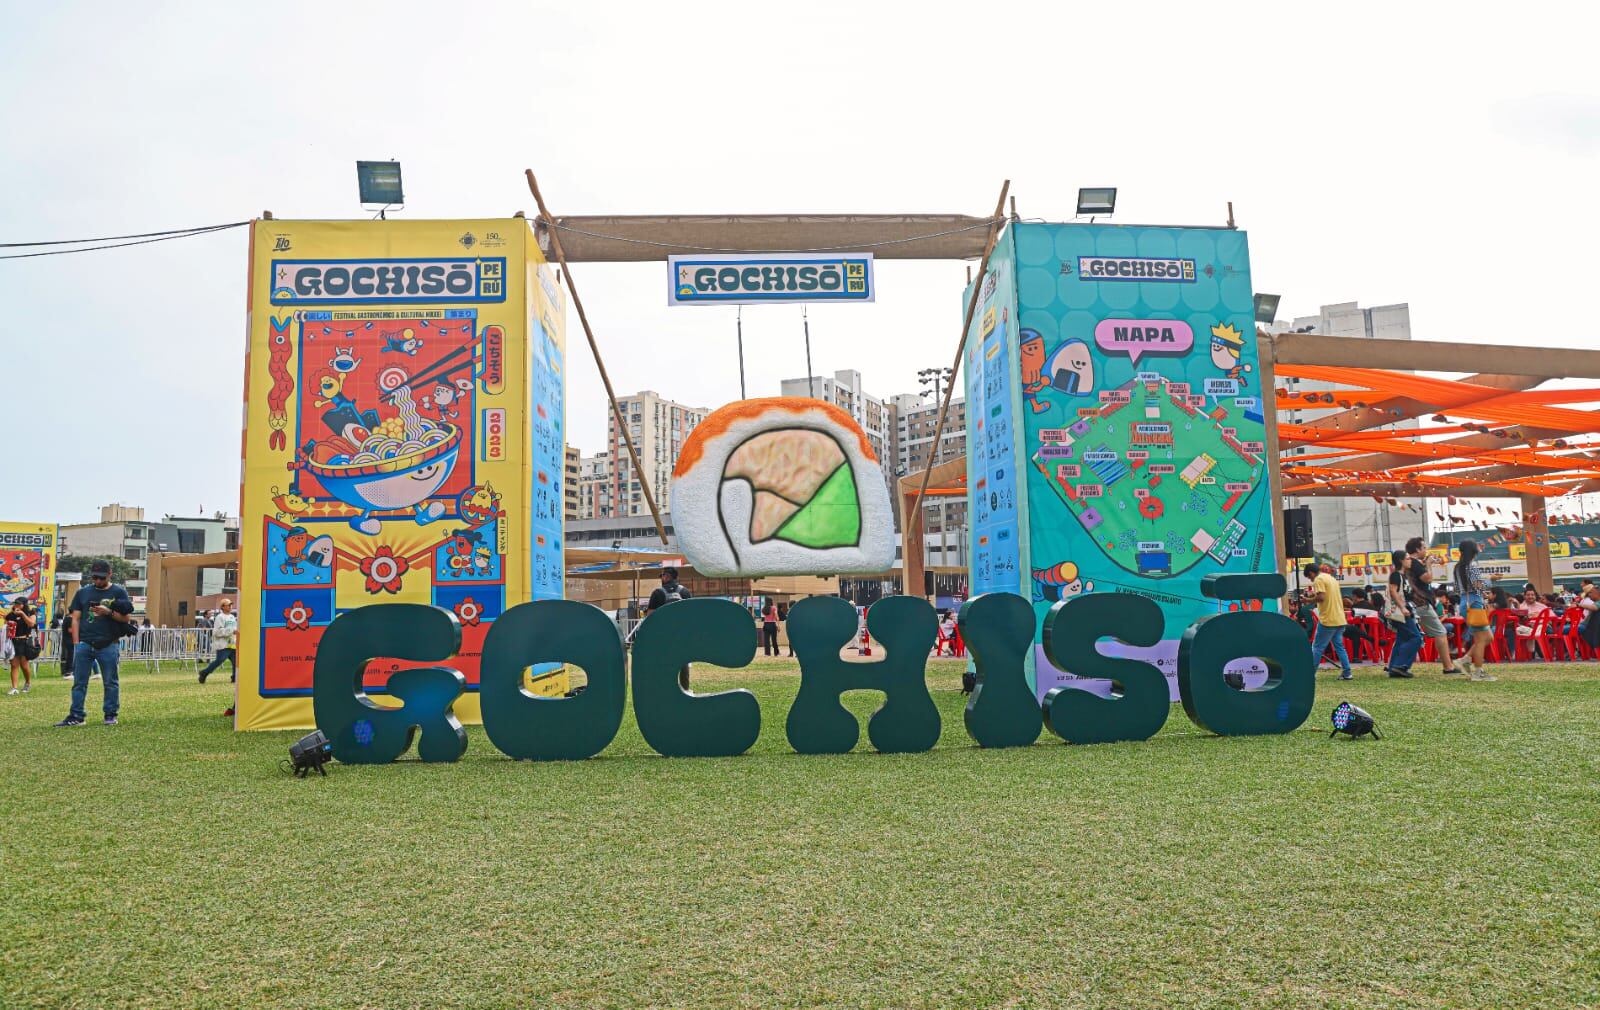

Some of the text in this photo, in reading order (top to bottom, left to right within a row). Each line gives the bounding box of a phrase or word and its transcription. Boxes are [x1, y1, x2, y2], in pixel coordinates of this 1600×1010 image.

[483, 263, 499, 275] PE
[849, 264, 862, 275] PE
[1090, 259, 1180, 278] GOCHISŌ
[295, 264, 473, 296] GOCHISŌ
[694, 265, 841, 292] GOCHISŌ
[849, 277, 864, 291] RÚ
[482, 280, 500, 294] RÚ
[334, 312, 356, 320] FESTIVAL
[1113, 327, 1175, 342] MAPA
[489, 412, 502, 458] 2023
[314, 572, 1316, 763] GOCHISŌ
